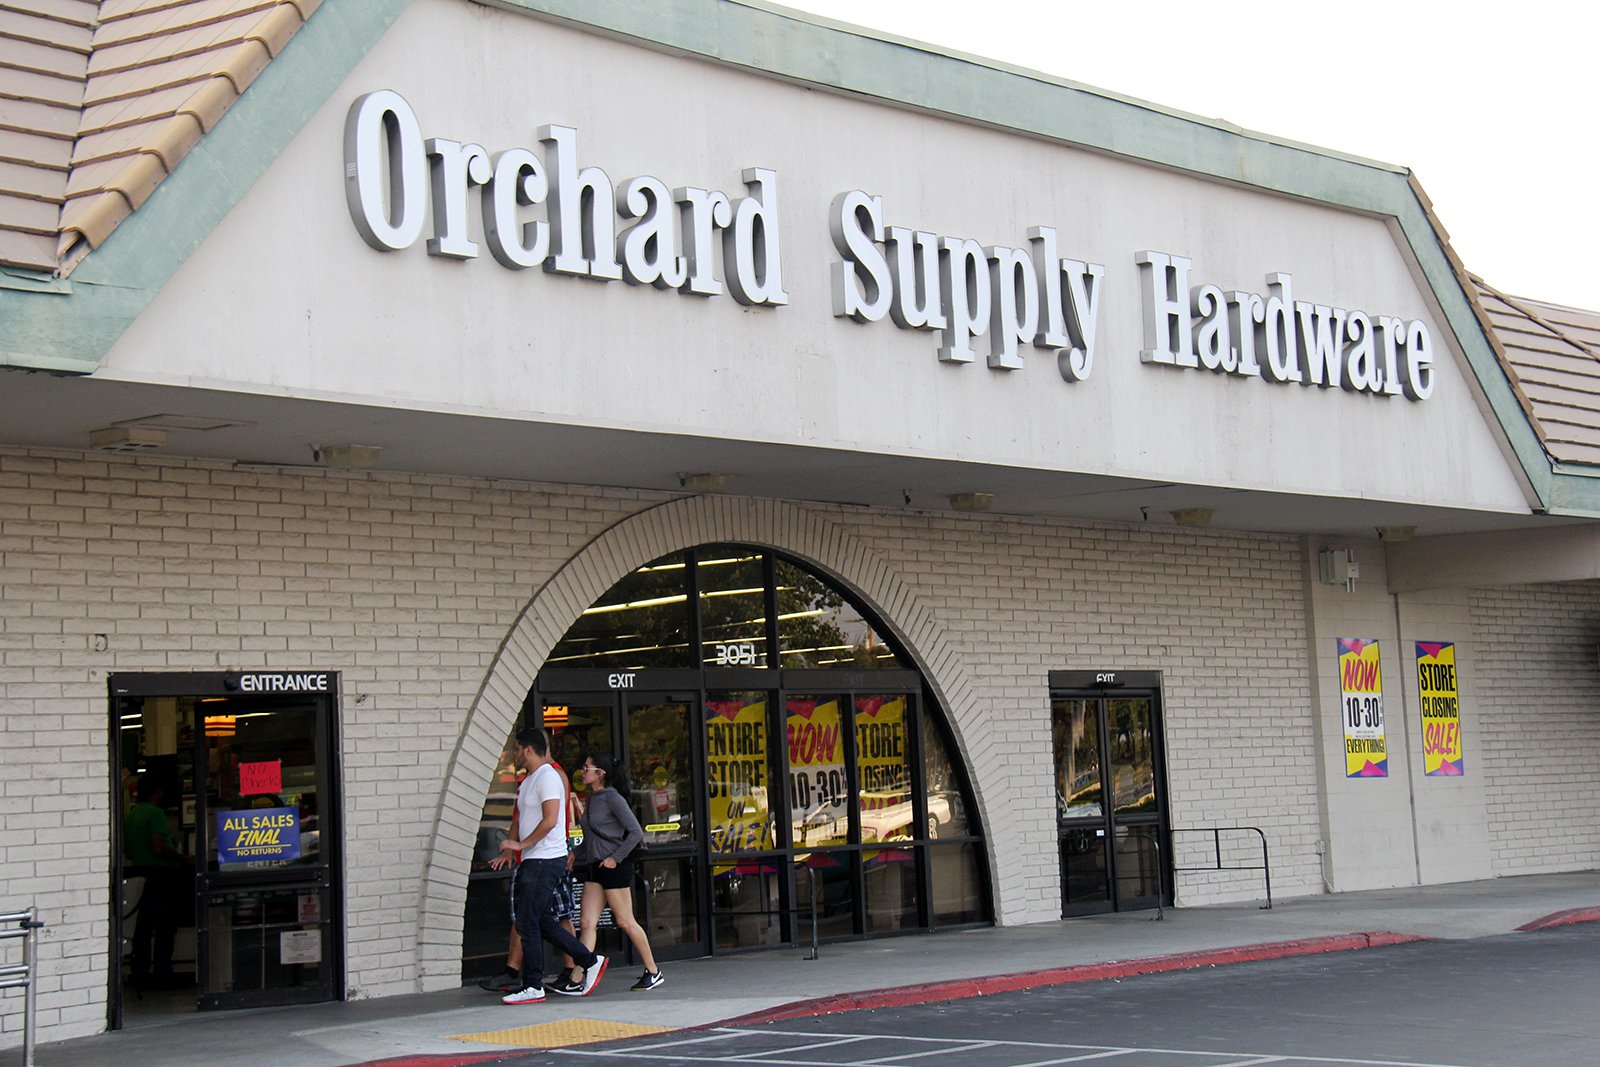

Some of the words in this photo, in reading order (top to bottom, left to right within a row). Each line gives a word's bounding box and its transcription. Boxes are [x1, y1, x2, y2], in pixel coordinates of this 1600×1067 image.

[343, 88, 788, 308] Orchard
[829, 190, 1105, 383] Supply
[1135, 249, 1434, 402] Hardware
[715, 644, 756, 665] 3051
[240, 674, 327, 691] ENTRANCE
[608, 673, 636, 688] EXIT
[1096, 673, 1115, 683] EXIT
[1343, 658, 1379, 692] NOW
[1420, 663, 1455, 691] STORE
[1422, 696, 1457, 718] CLOSING
[706, 721, 764, 757] ENTIRE
[787, 721, 839, 764] NOW
[1425, 722, 1460, 755] SALE!
[707, 759, 765, 799] STORE
[727, 800, 746, 819] ON
[223, 817, 249, 831] ALL
[252, 814, 295, 829] SALES
[235, 828, 281, 847] FINAL
[251, 846, 282, 855] RETURNS
